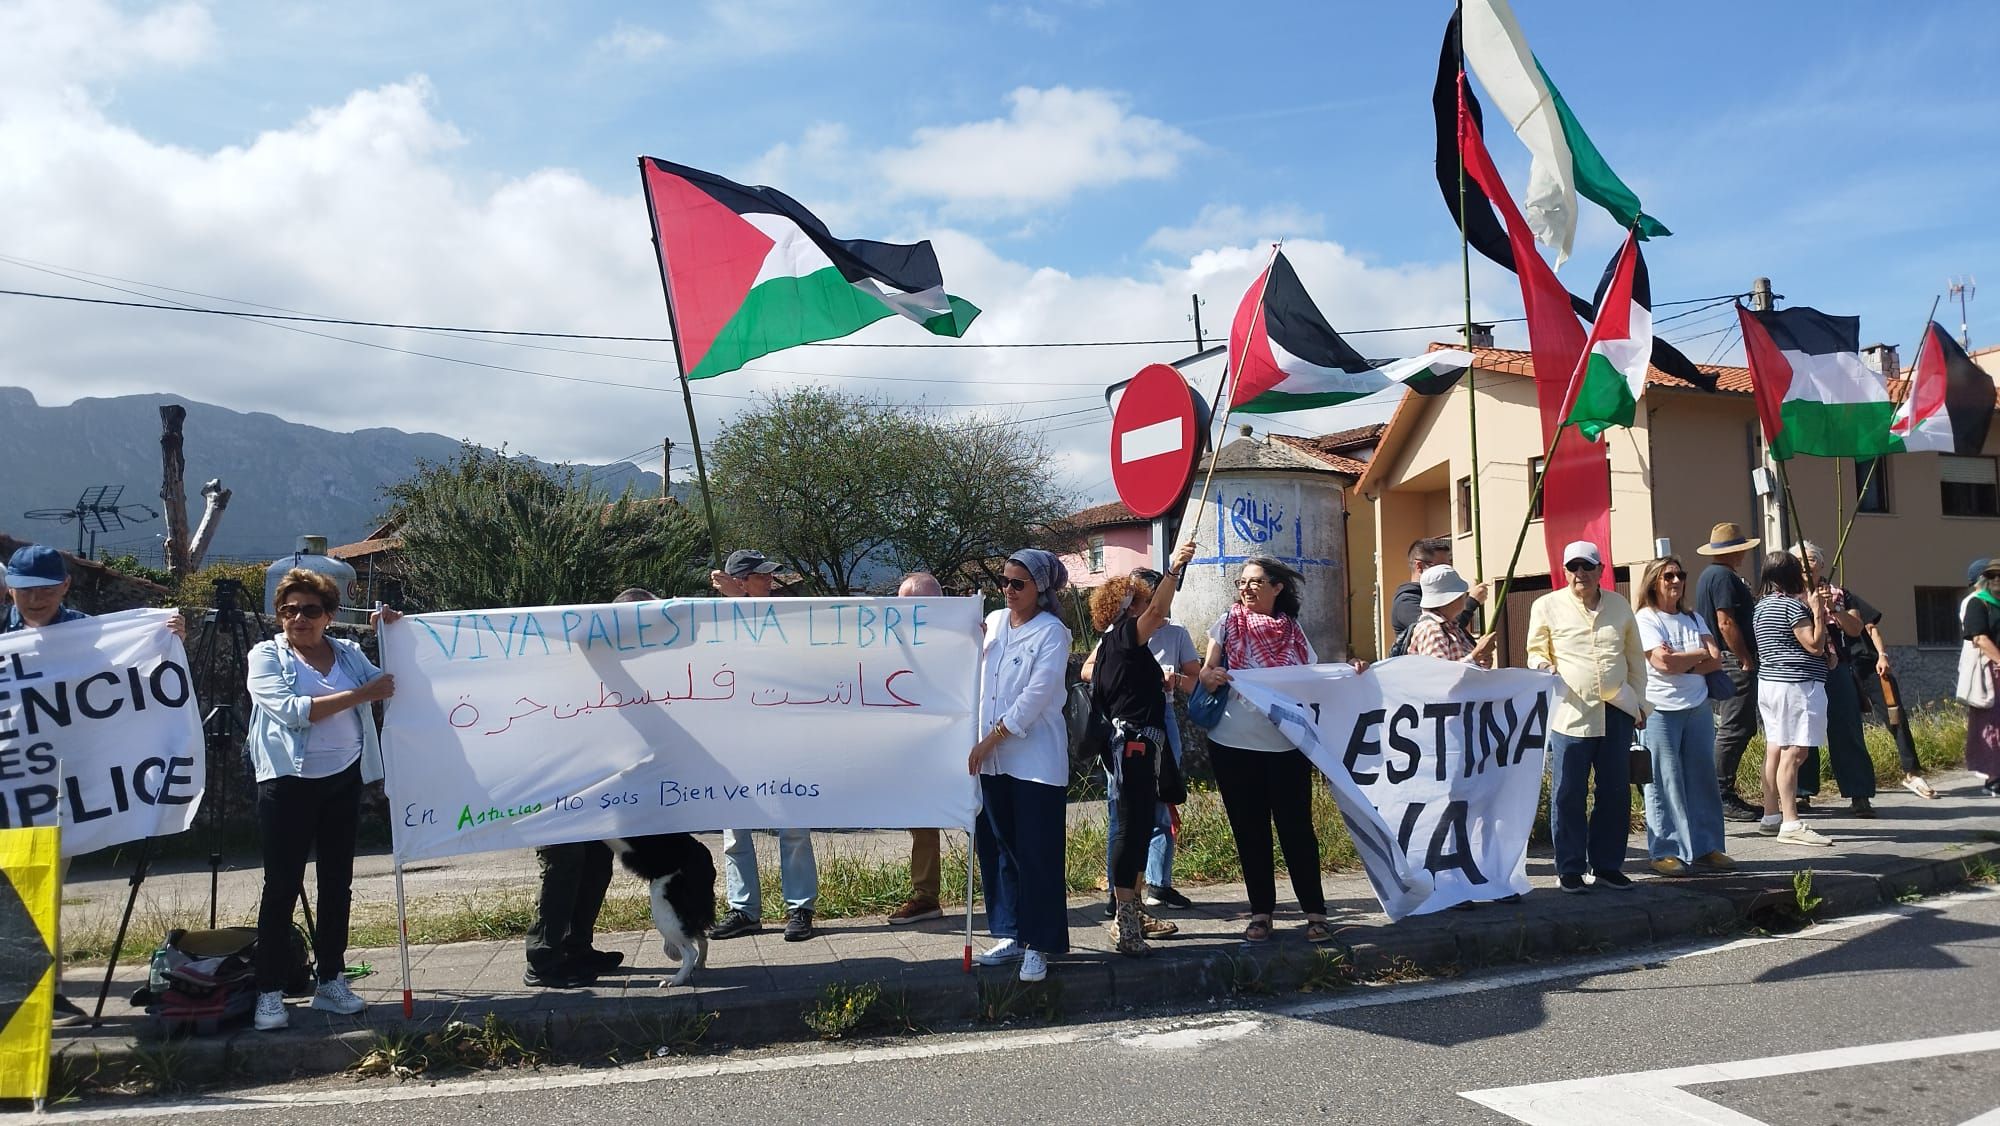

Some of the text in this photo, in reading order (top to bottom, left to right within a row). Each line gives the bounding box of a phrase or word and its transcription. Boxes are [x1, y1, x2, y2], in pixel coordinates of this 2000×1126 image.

[414, 599, 928, 660] VIVA PALESTINA LIBRE
[751, 661, 922, 707] عاشت
[449, 694, 548, 735] حرة
[1343, 691, 1549, 785] ESTINA
[405, 802, 438, 827] En
[456, 803, 542, 830] Asturias
